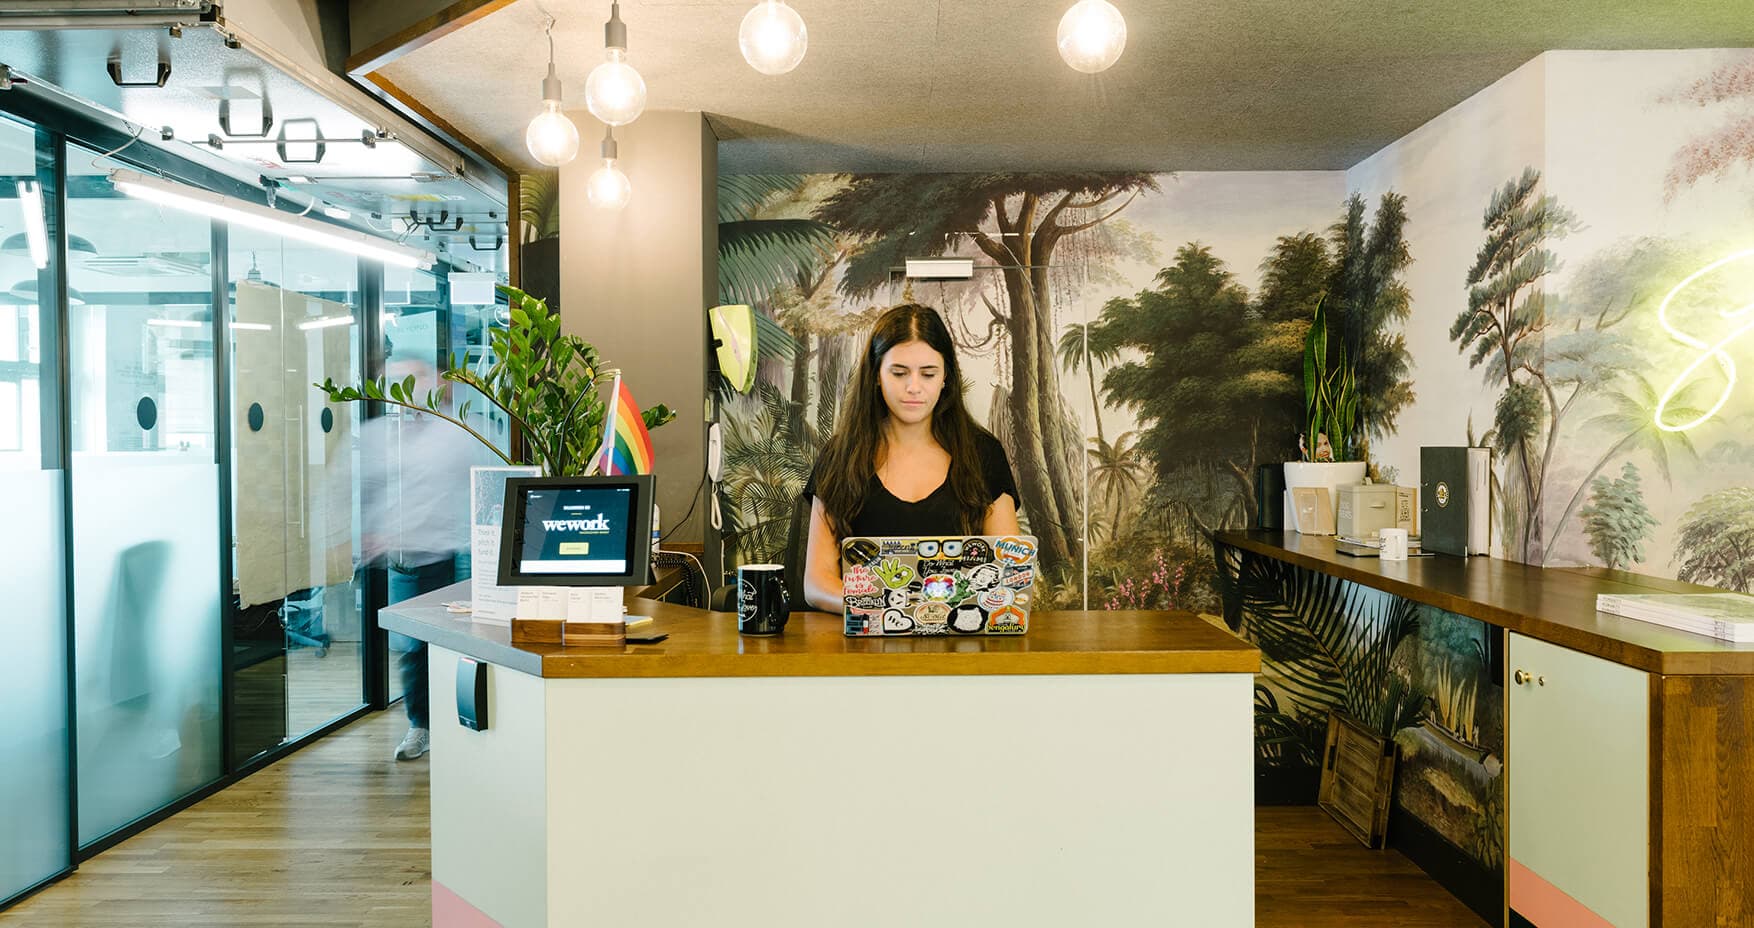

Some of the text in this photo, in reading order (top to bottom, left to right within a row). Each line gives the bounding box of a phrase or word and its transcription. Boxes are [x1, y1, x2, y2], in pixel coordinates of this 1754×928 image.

[542, 512, 610, 532] wework
[994, 540, 1036, 557] MUNICH
[1004, 571, 1031, 584] LONDON
